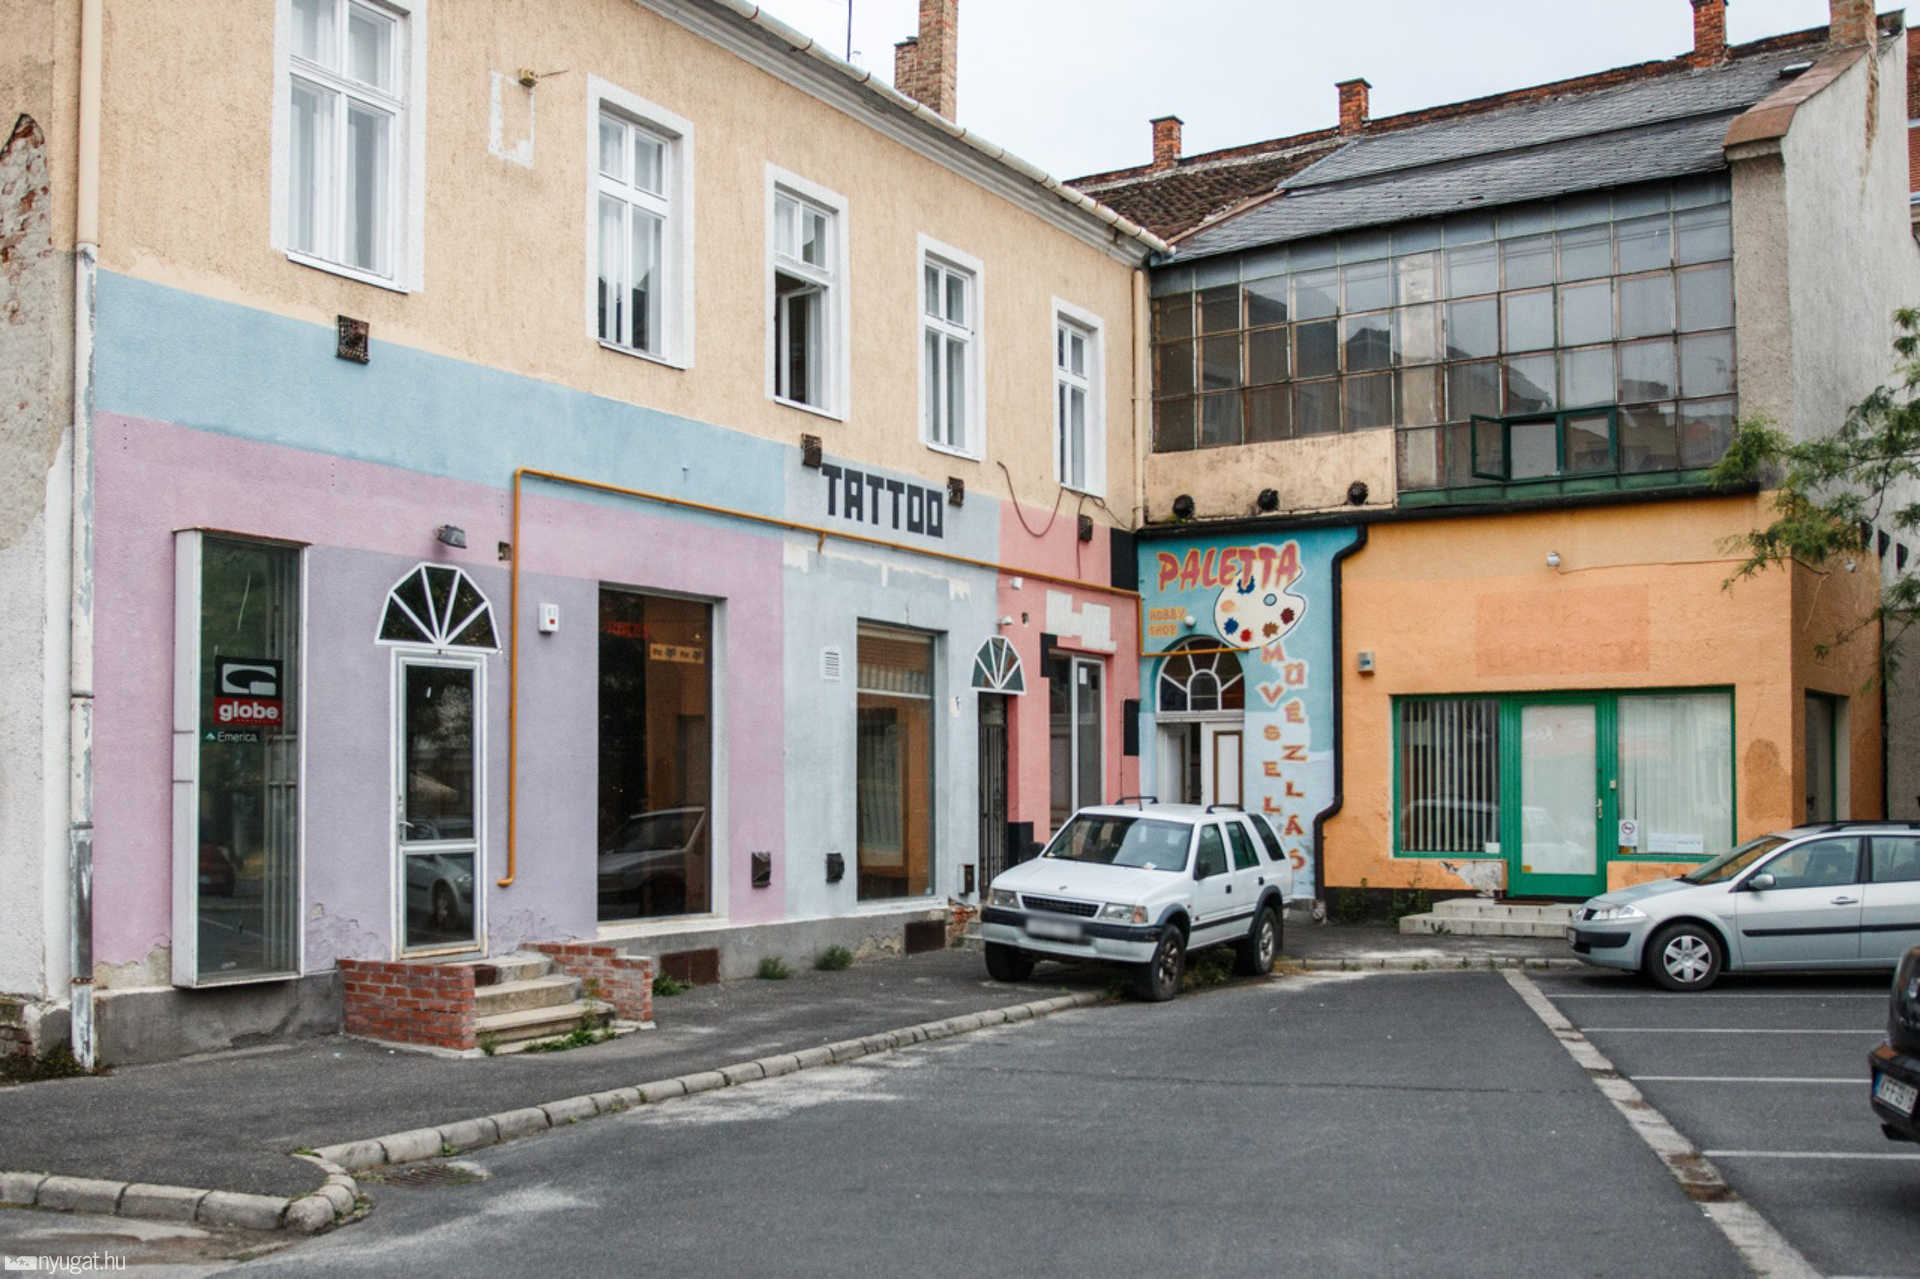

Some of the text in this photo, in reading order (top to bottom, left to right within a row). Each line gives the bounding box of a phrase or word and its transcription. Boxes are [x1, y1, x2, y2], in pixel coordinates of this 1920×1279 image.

[822, 463, 943, 539] TATTOO
[1157, 541, 1298, 592] PALETTA
[219, 701, 279, 721] globe
[217, 731, 258, 743] Emerica
